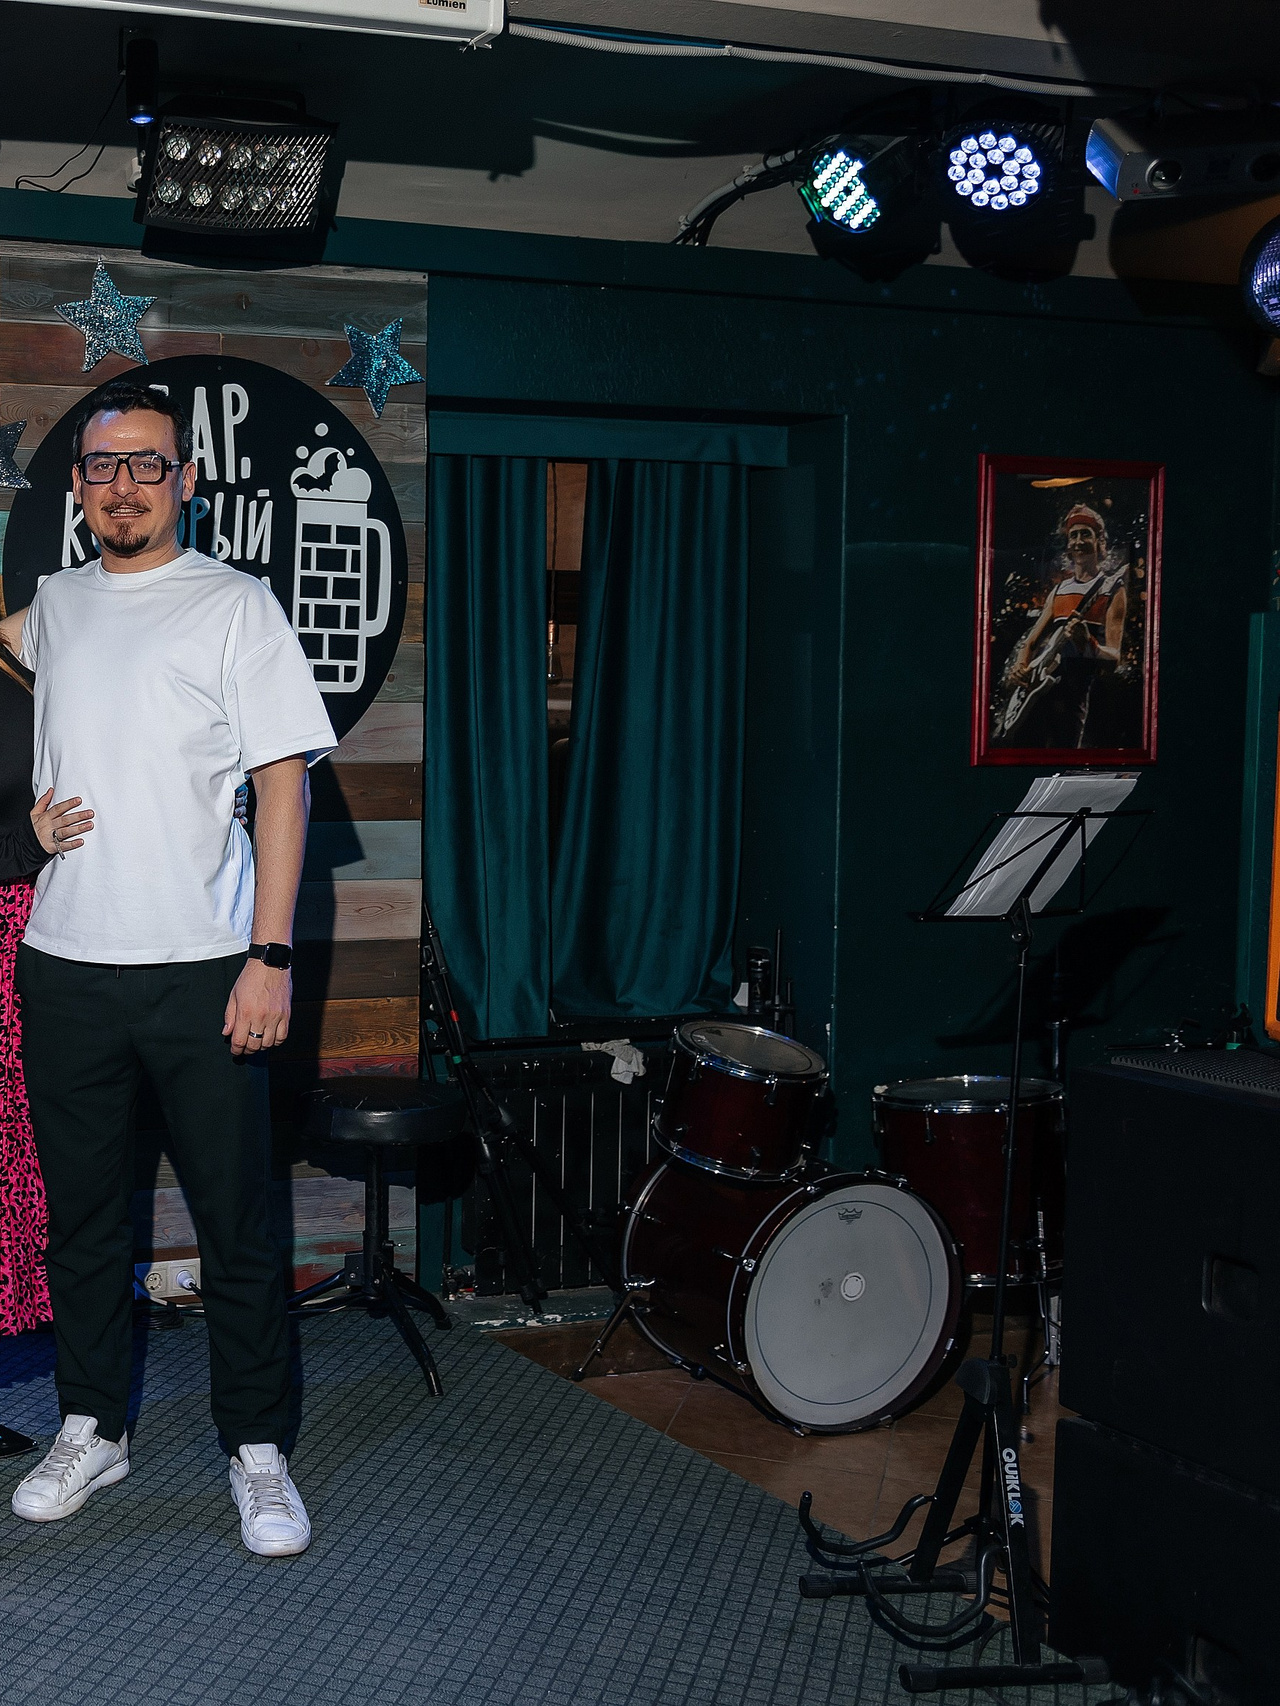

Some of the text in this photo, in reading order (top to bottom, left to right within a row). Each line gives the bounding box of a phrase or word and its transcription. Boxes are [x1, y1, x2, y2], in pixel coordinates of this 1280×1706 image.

[149, 383, 251, 484] АР.
[61, 488, 274, 568] КРЫЙ
[1002, 1447, 1025, 1528] QUIKLOK
